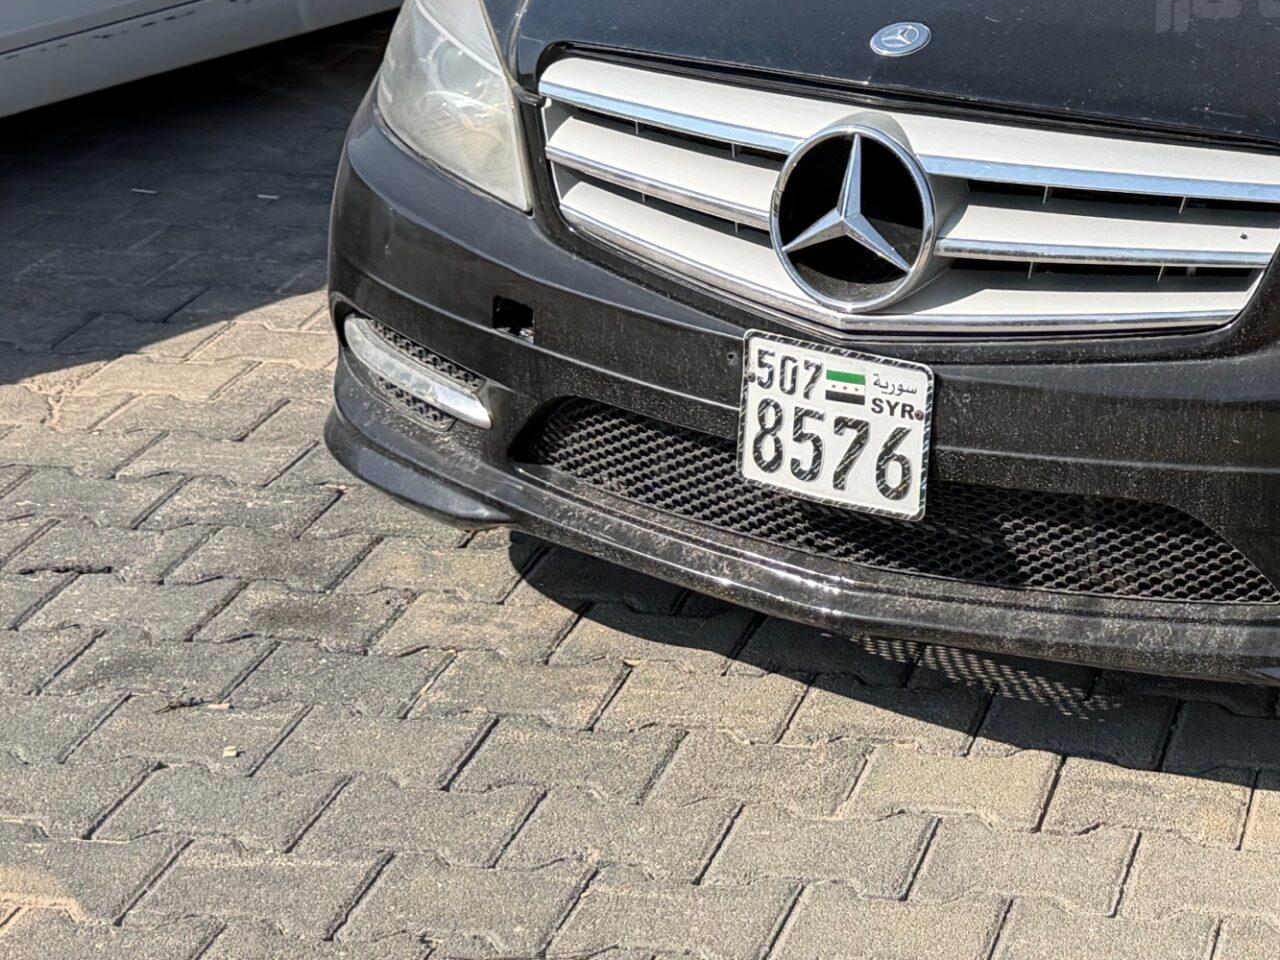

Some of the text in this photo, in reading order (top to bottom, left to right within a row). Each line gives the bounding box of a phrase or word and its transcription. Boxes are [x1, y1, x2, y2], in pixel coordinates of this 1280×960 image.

[757, 348, 823, 400] 507
[872, 373, 918, 396] سورية
[871, 397, 915, 421] SYR
[752, 398, 913, 501] 8576
